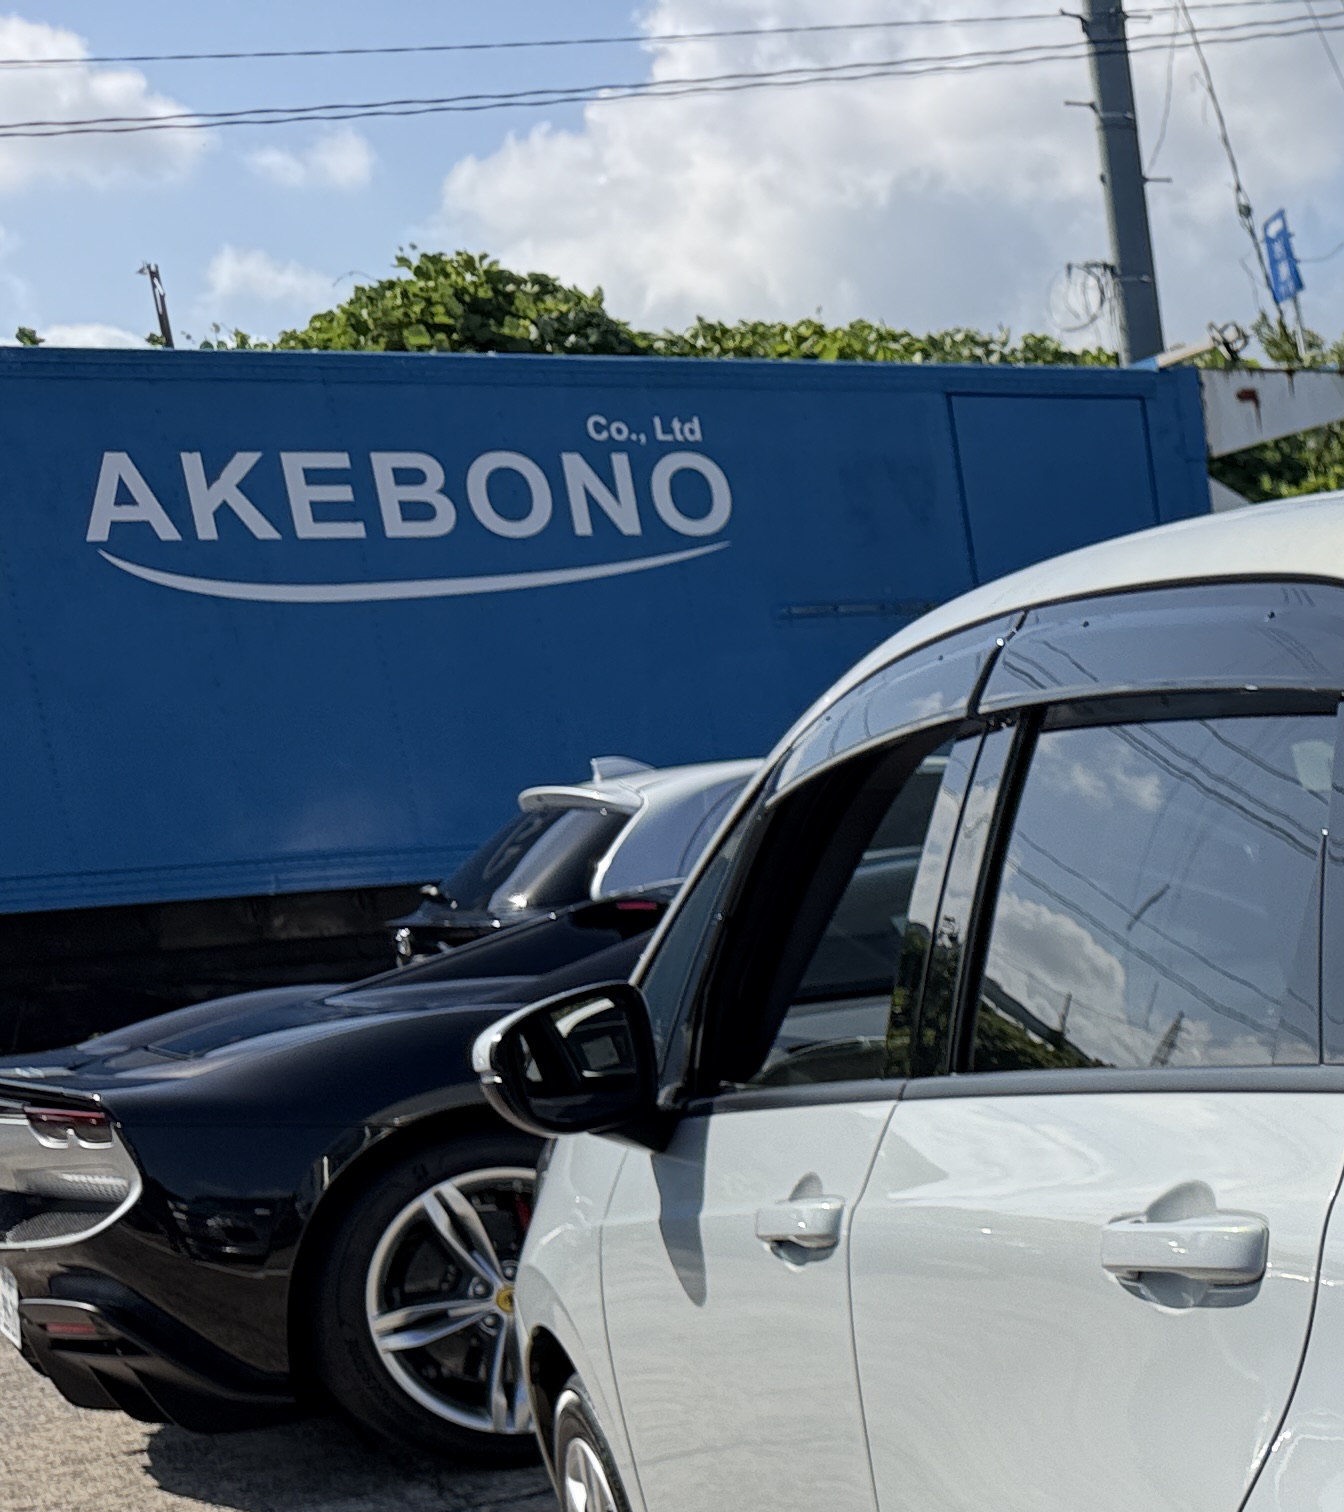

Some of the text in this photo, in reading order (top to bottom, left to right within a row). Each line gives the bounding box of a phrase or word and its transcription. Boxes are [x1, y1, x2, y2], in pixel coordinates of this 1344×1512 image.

[586, 413, 703, 445] Co., Ltd
[86, 450, 733, 542] AKEBONO
